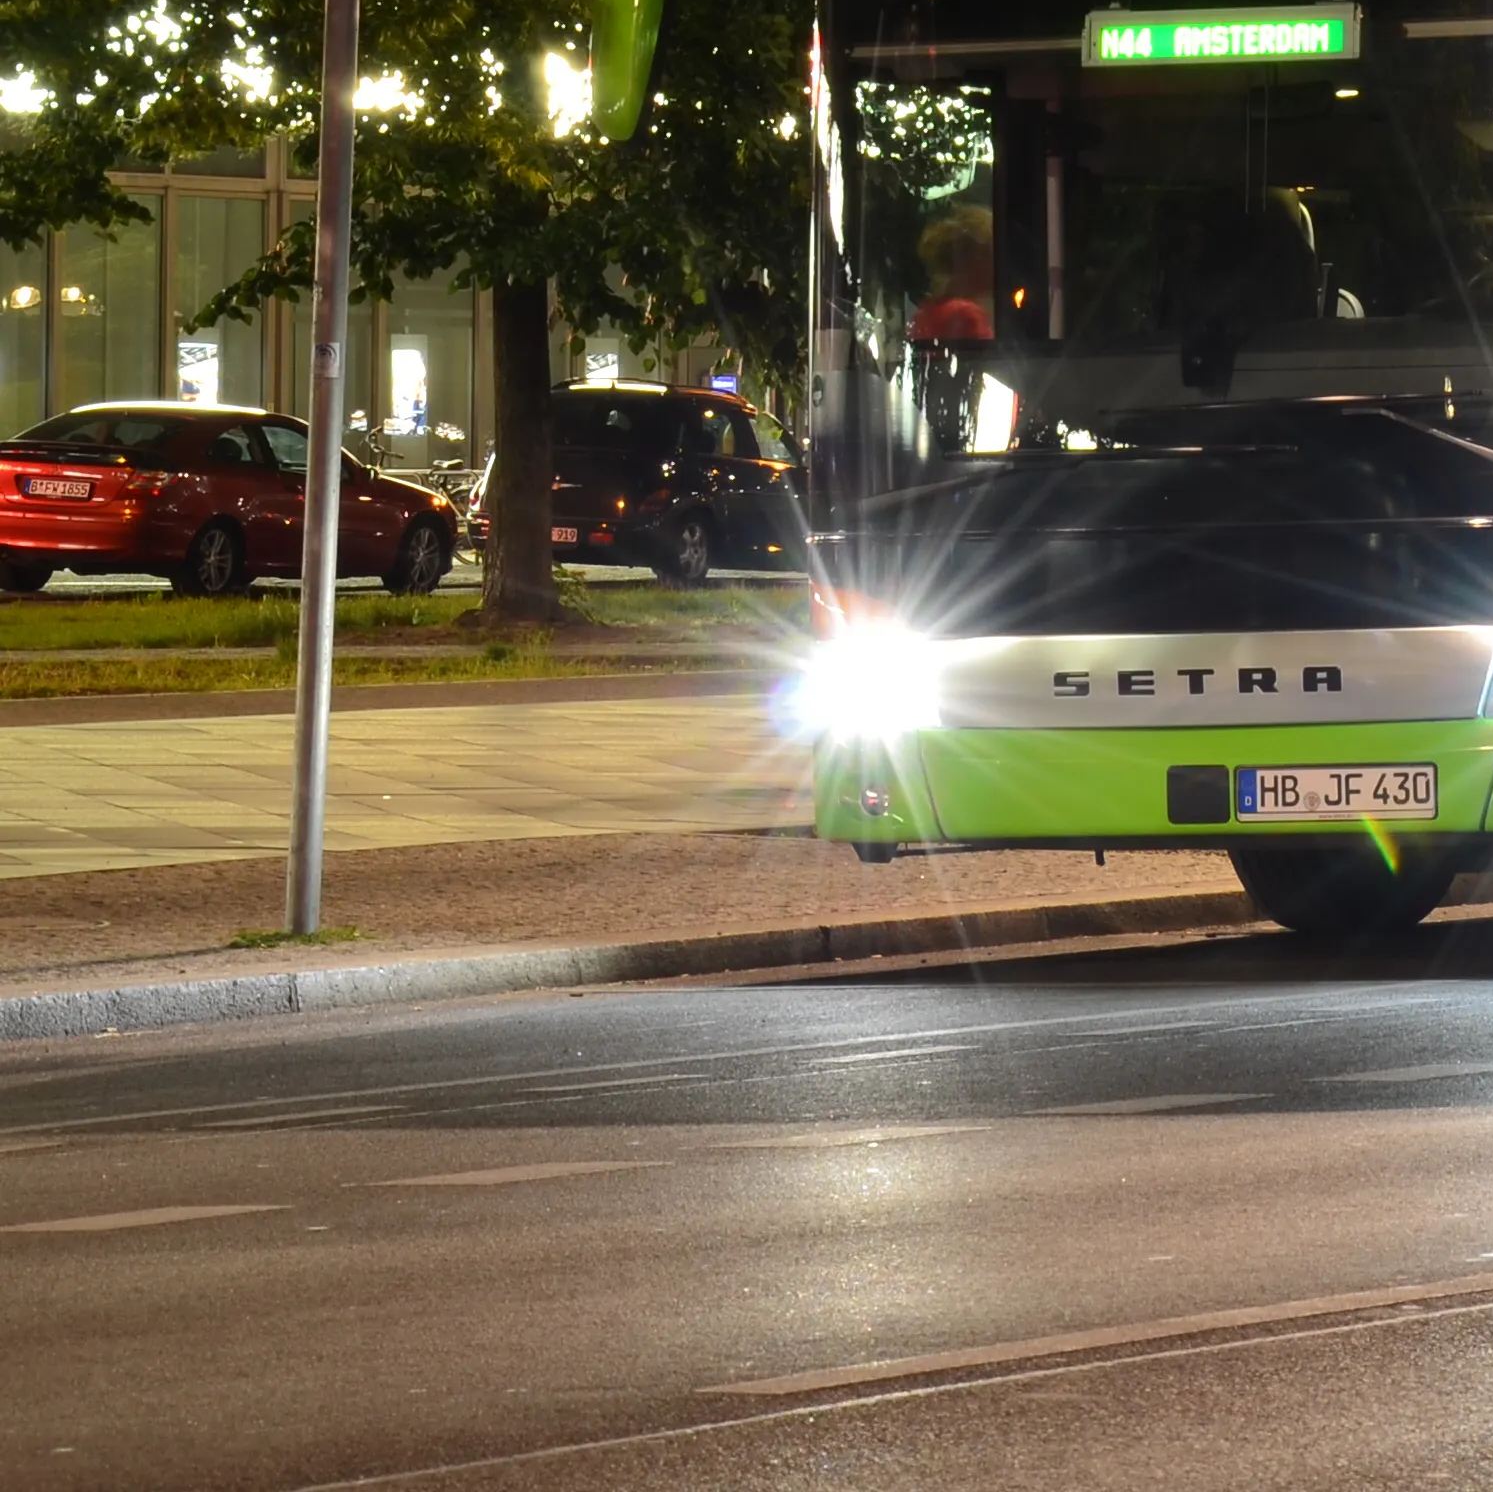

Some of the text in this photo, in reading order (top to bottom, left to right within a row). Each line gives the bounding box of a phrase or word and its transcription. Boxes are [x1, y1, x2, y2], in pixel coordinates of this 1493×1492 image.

[1100, 22, 1330, 59] N44 AMSTERDAM
[1053, 666, 1343, 697] SETRA
[1244, 772, 1431, 807] D HB JF 430
